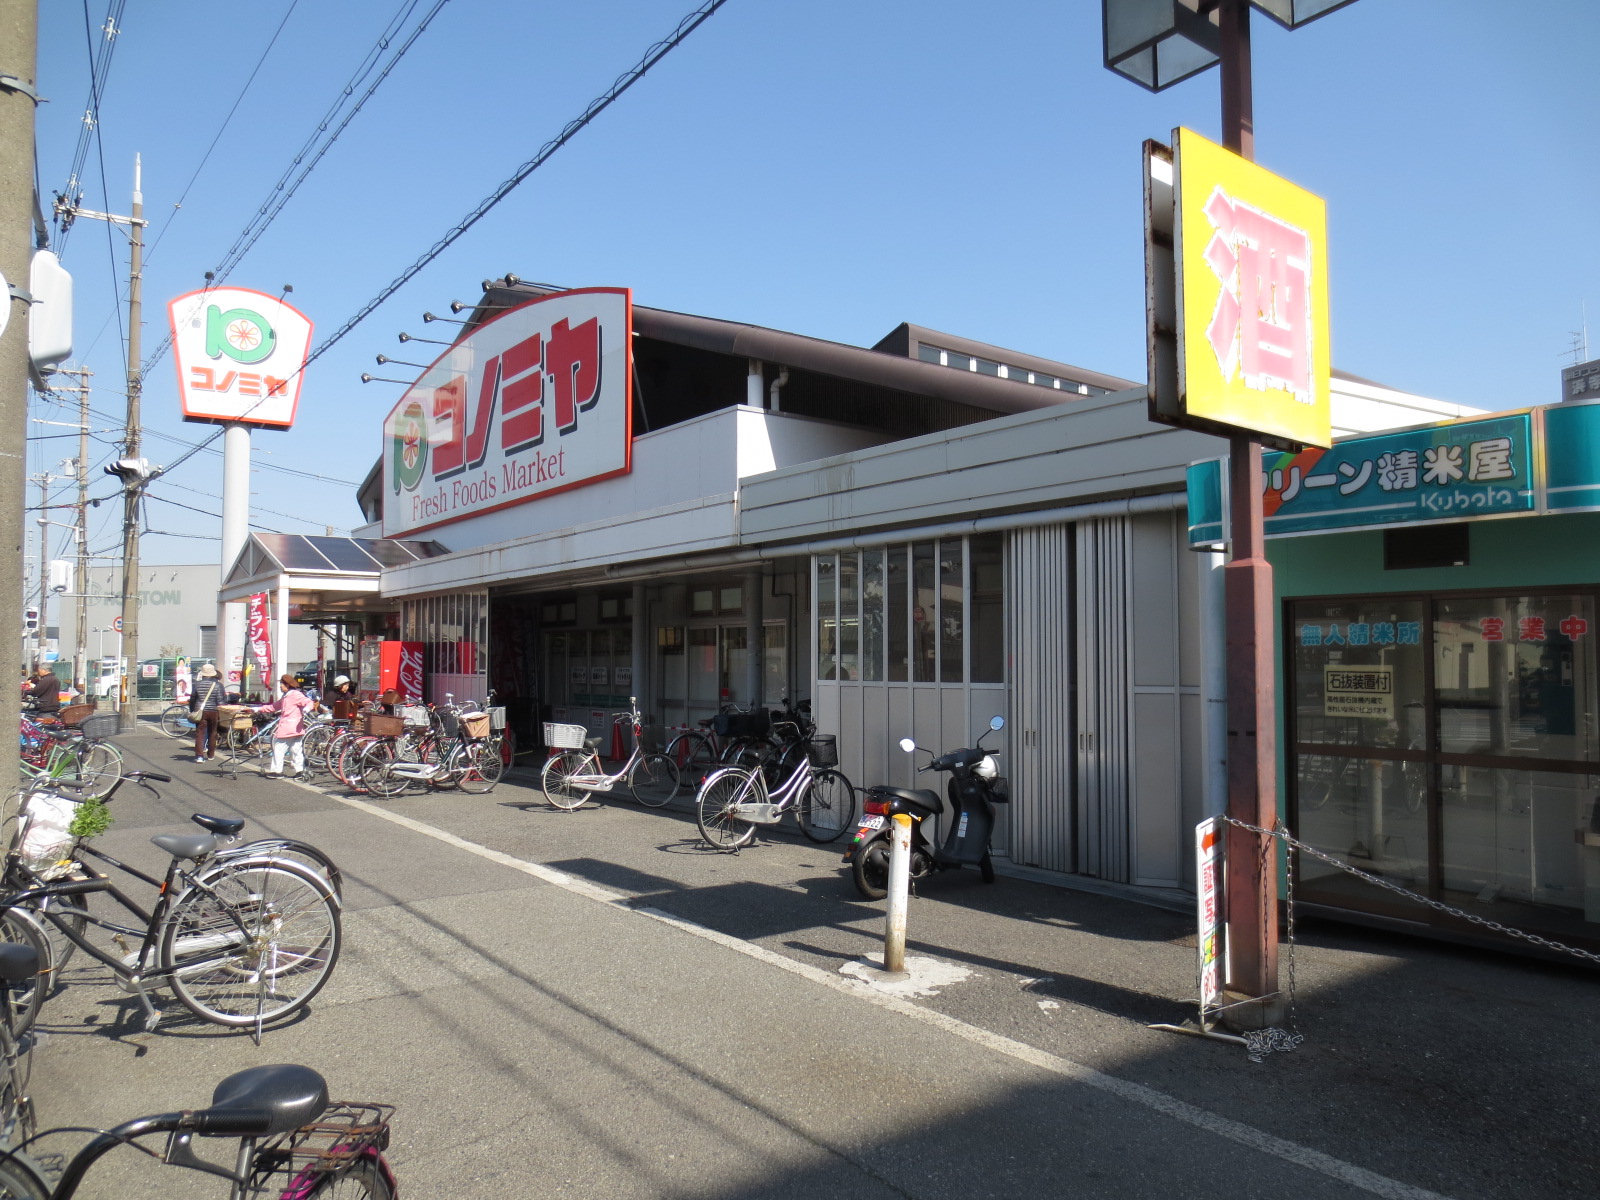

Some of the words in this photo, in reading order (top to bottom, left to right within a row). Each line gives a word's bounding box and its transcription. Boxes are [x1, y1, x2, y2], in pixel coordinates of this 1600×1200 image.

[1203, 185, 1313, 403] 酒
[190, 365, 289, 398] コノミヤ
[432, 316, 602, 484] コノミヤ
[412, 486, 448, 522] Fresh
[452, 470, 497, 509] Foods
[502, 443, 566, 494] Market
[1421, 486, 1512, 512] Kubota
[1300, 621, 1421, 646] 無人精米所
[1329, 673, 1388, 690] 石抜装置付
